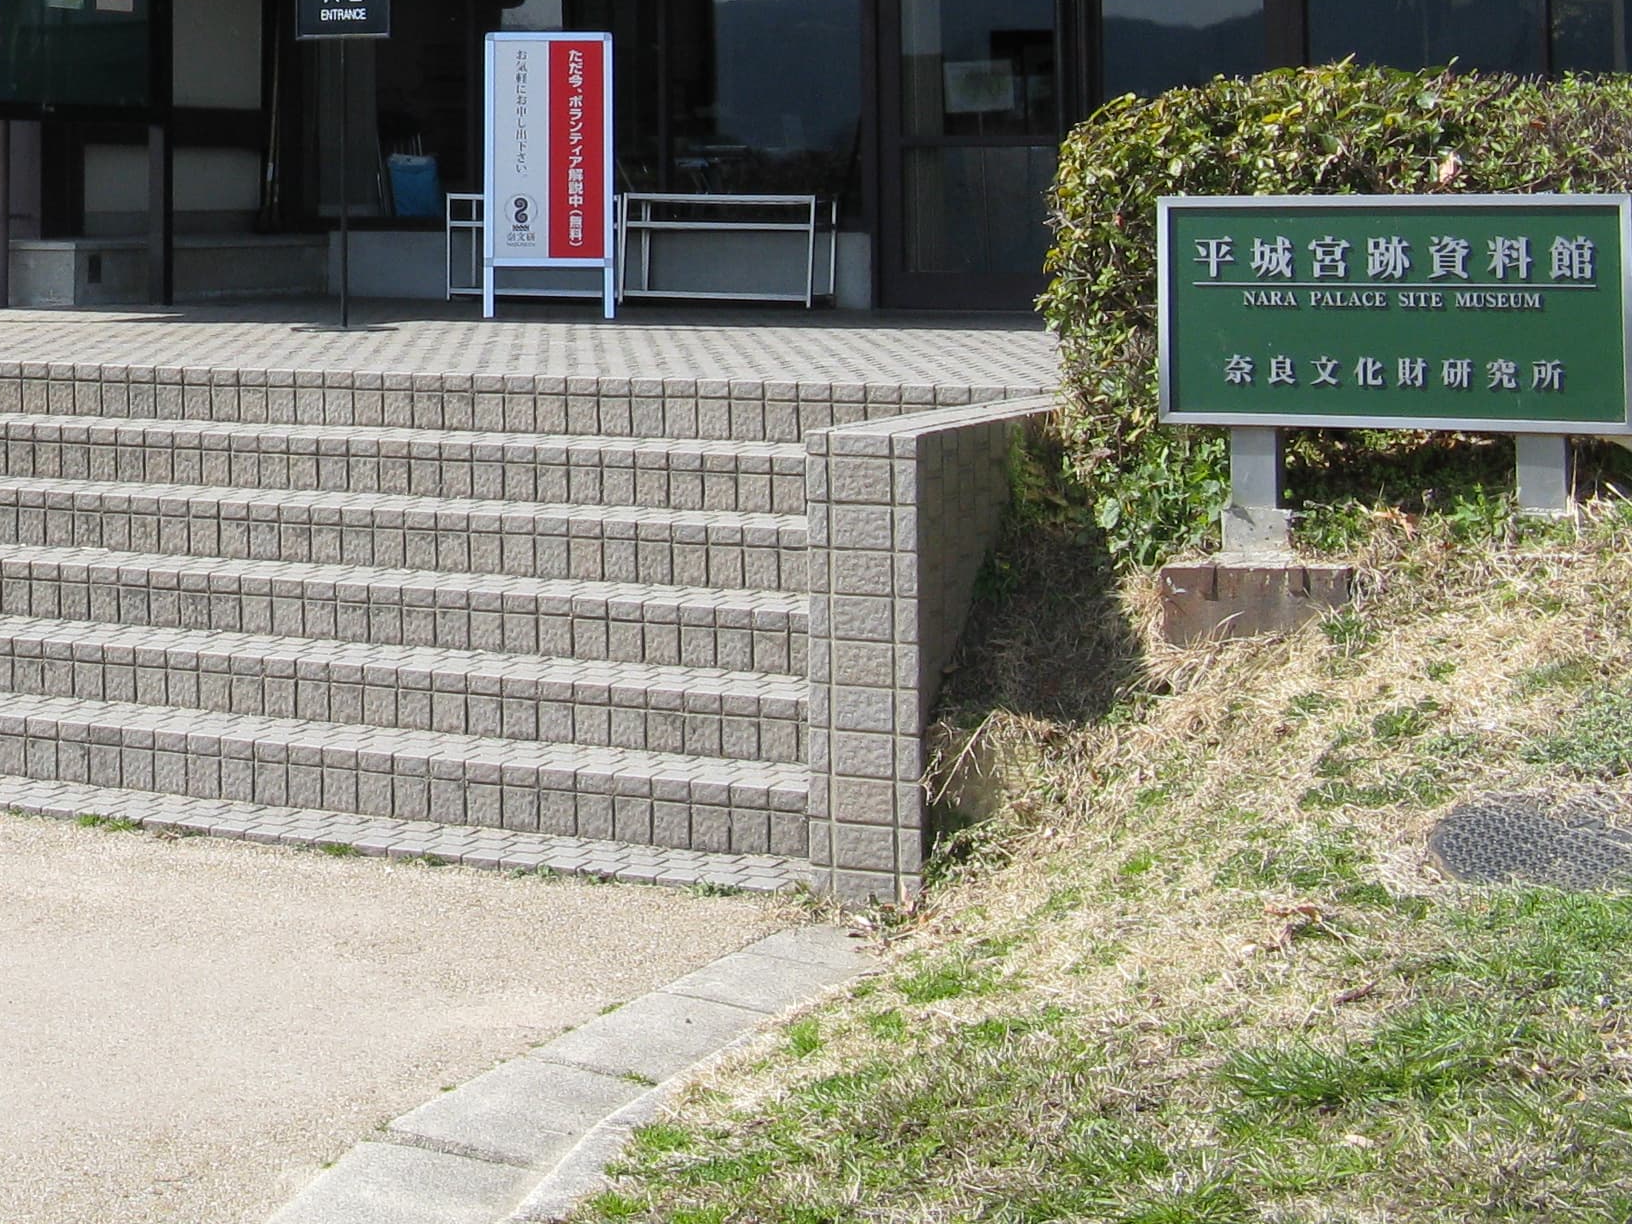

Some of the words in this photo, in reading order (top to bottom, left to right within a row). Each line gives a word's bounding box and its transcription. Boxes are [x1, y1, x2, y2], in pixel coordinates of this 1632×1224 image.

[320, 7, 367, 22] ENTRANCE
[1192, 235, 1597, 280] 平城宮跡資料館
[1242, 290, 1298, 308] NARA
[1309, 291, 1387, 308] PALACE
[1397, 291, 1444, 309] SITE
[1454, 292, 1543, 310] MUSEUM
[1223, 354, 1565, 392] 奈良文化財研究所
